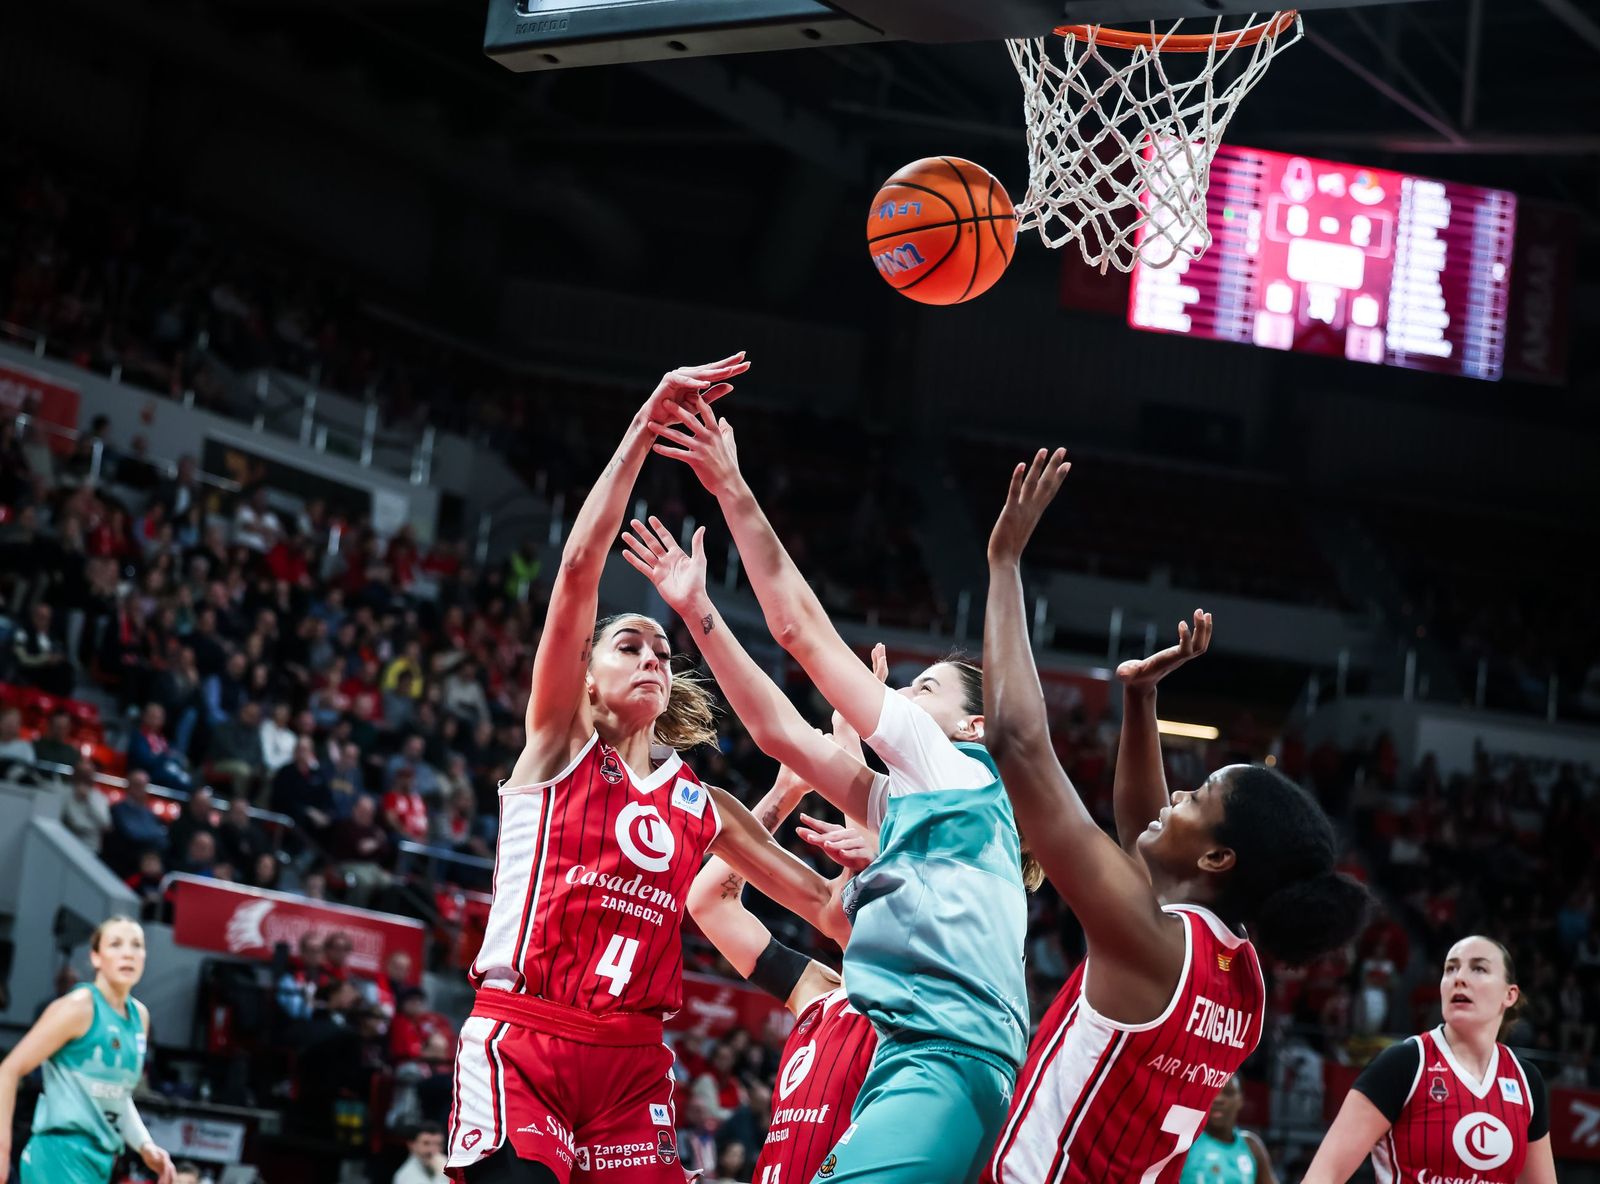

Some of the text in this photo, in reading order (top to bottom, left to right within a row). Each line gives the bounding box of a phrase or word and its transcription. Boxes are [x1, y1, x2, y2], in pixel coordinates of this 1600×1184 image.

[515, 19, 568, 35] MONDO
[565, 864, 677, 912] Casadem
[600, 894, 664, 927] ZARAGOZA
[594, 933, 640, 998] 4
[1185, 994, 1252, 1049] FINGALL
[1147, 1053, 1181, 1076] AIR
[546, 1115, 576, 1155] Silk
[593, 1141, 654, 1157] Zaragoza
[1140, 1104, 1206, 1184] 7
